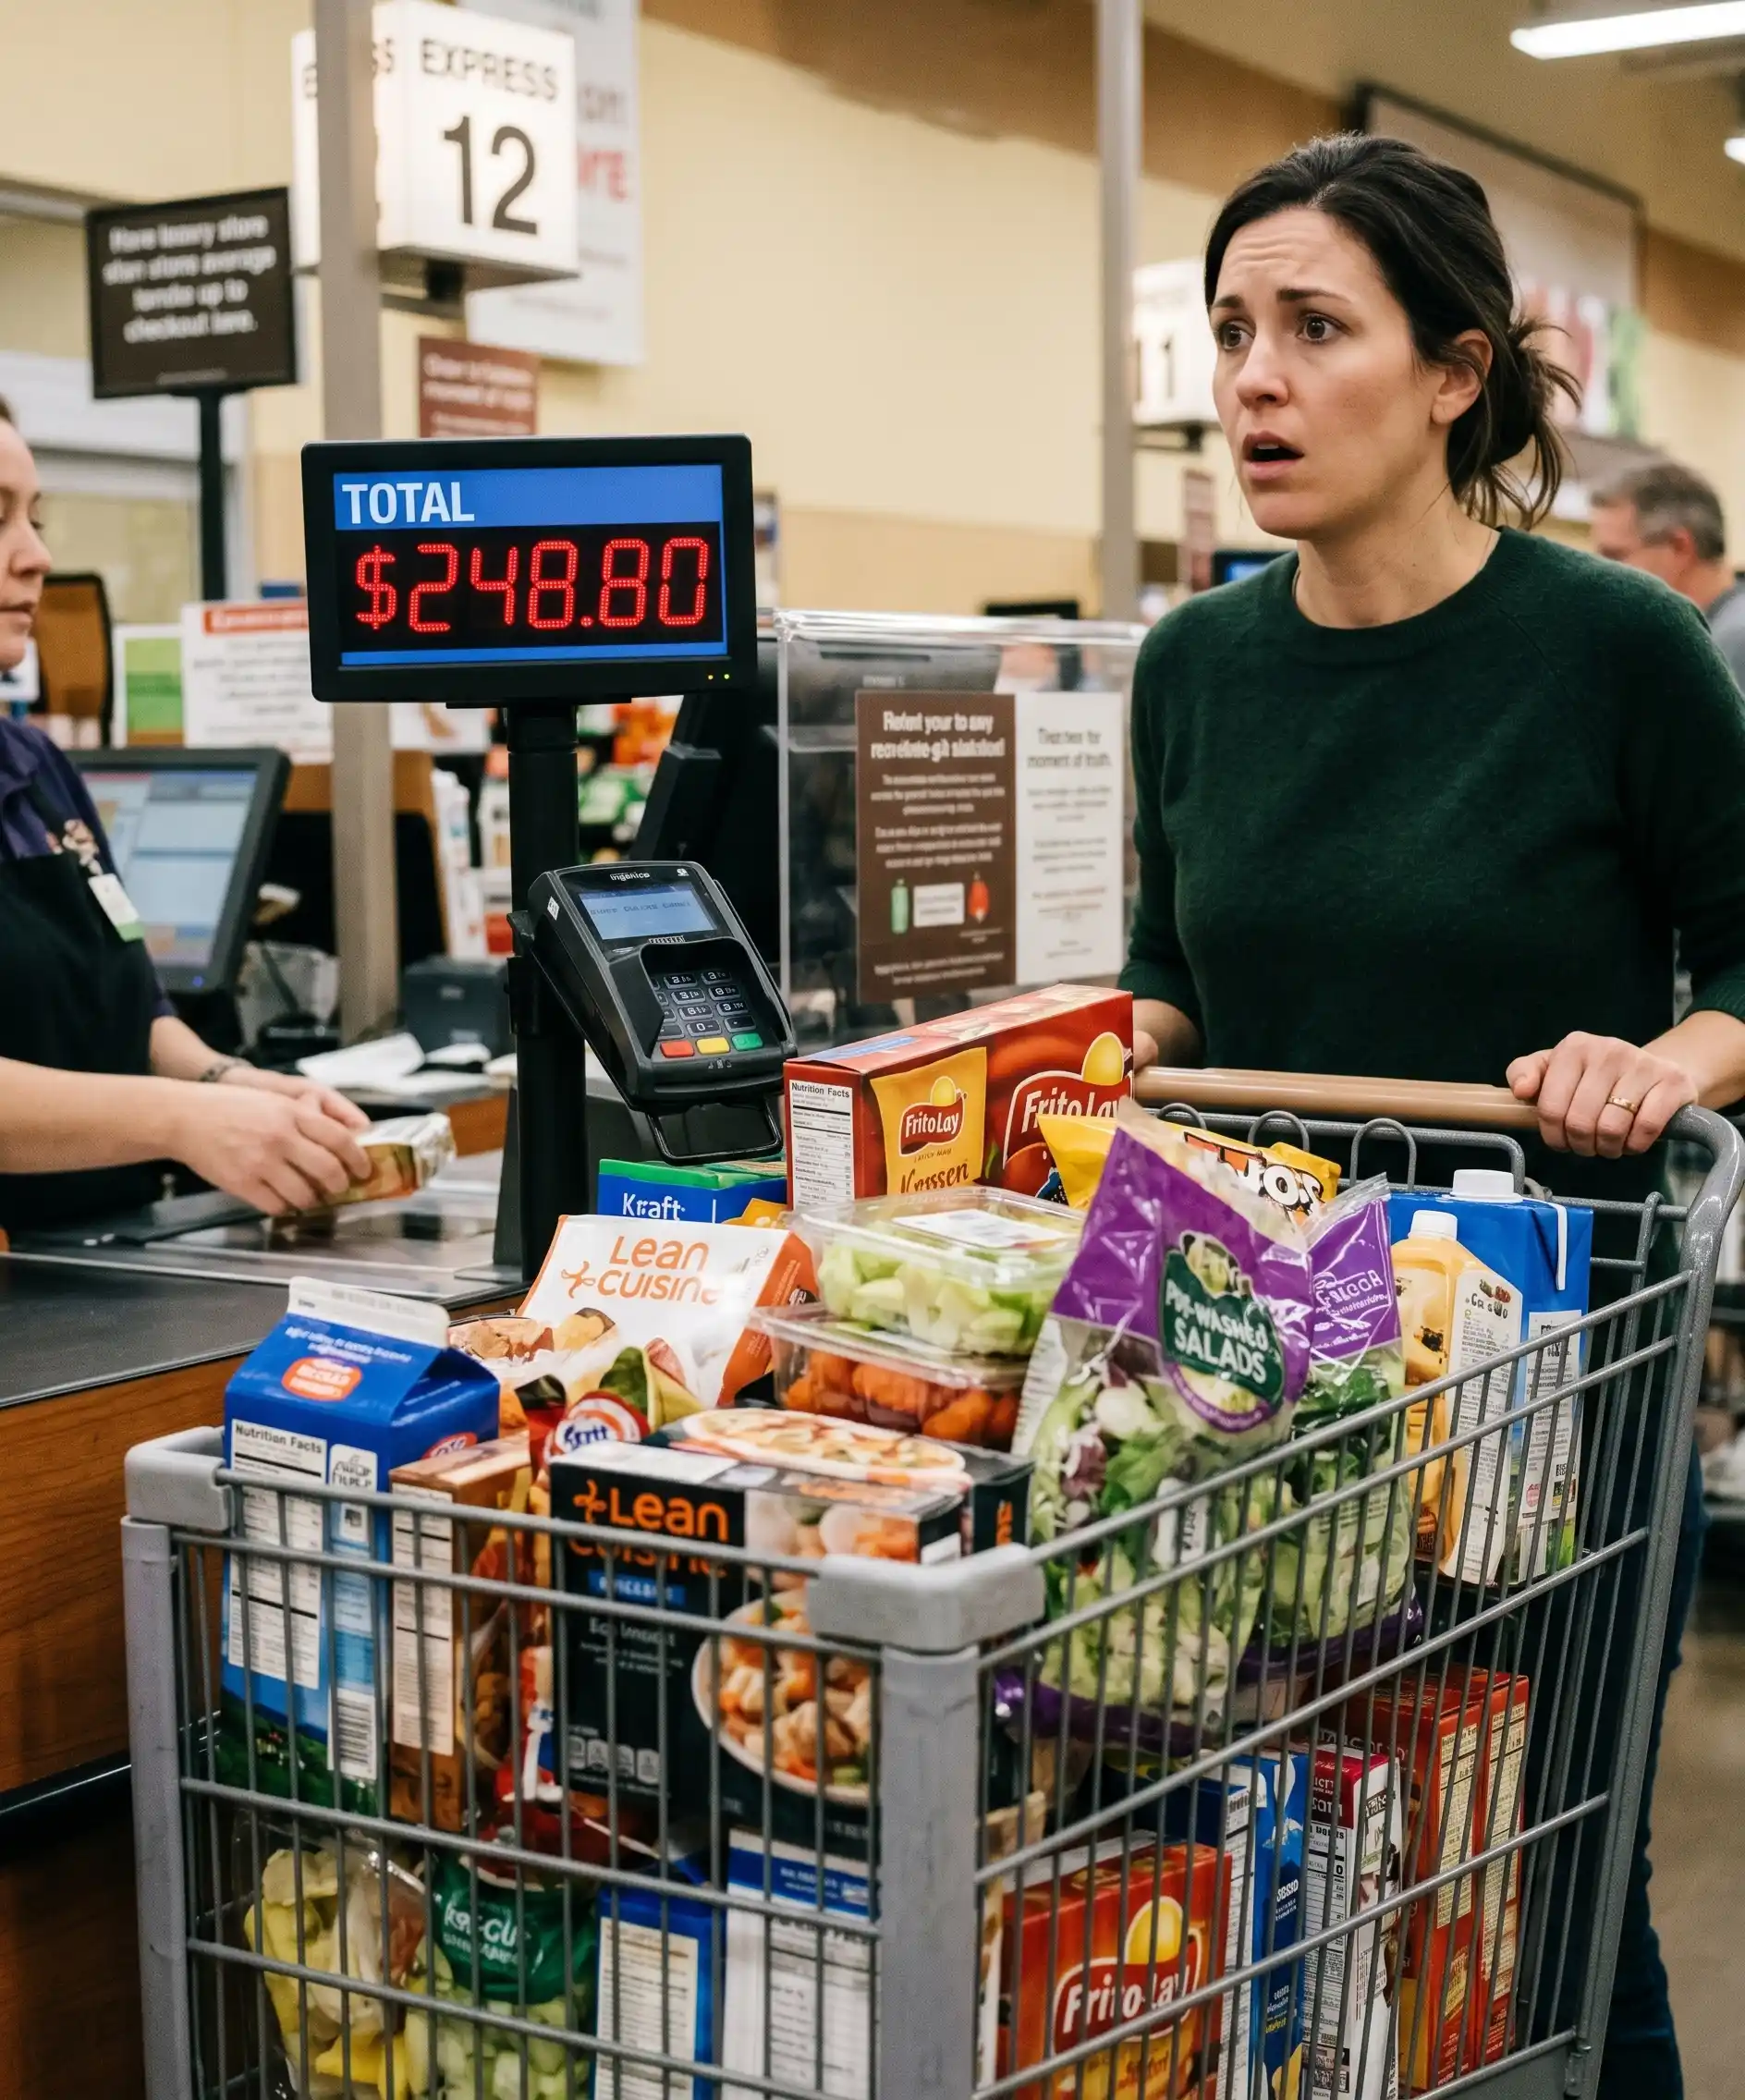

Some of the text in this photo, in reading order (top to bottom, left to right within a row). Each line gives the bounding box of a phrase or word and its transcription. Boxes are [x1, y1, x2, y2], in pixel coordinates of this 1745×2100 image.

[421, 37, 558, 104] EXPRESS
[441, 116, 537, 235] 12
[342, 482, 475, 524] TOTAL
[355, 536, 710, 633] $248.80
[791, 1082, 849, 1098] Nutrition Facts
[623, 1192, 681, 1220] Kraft
[609, 1236, 709, 1273] Lean
[1175, 1316, 1267, 1384] SALADS
[236, 1423, 322, 1454] Nutrition Facts
[610, 1487, 728, 1542] Lean
